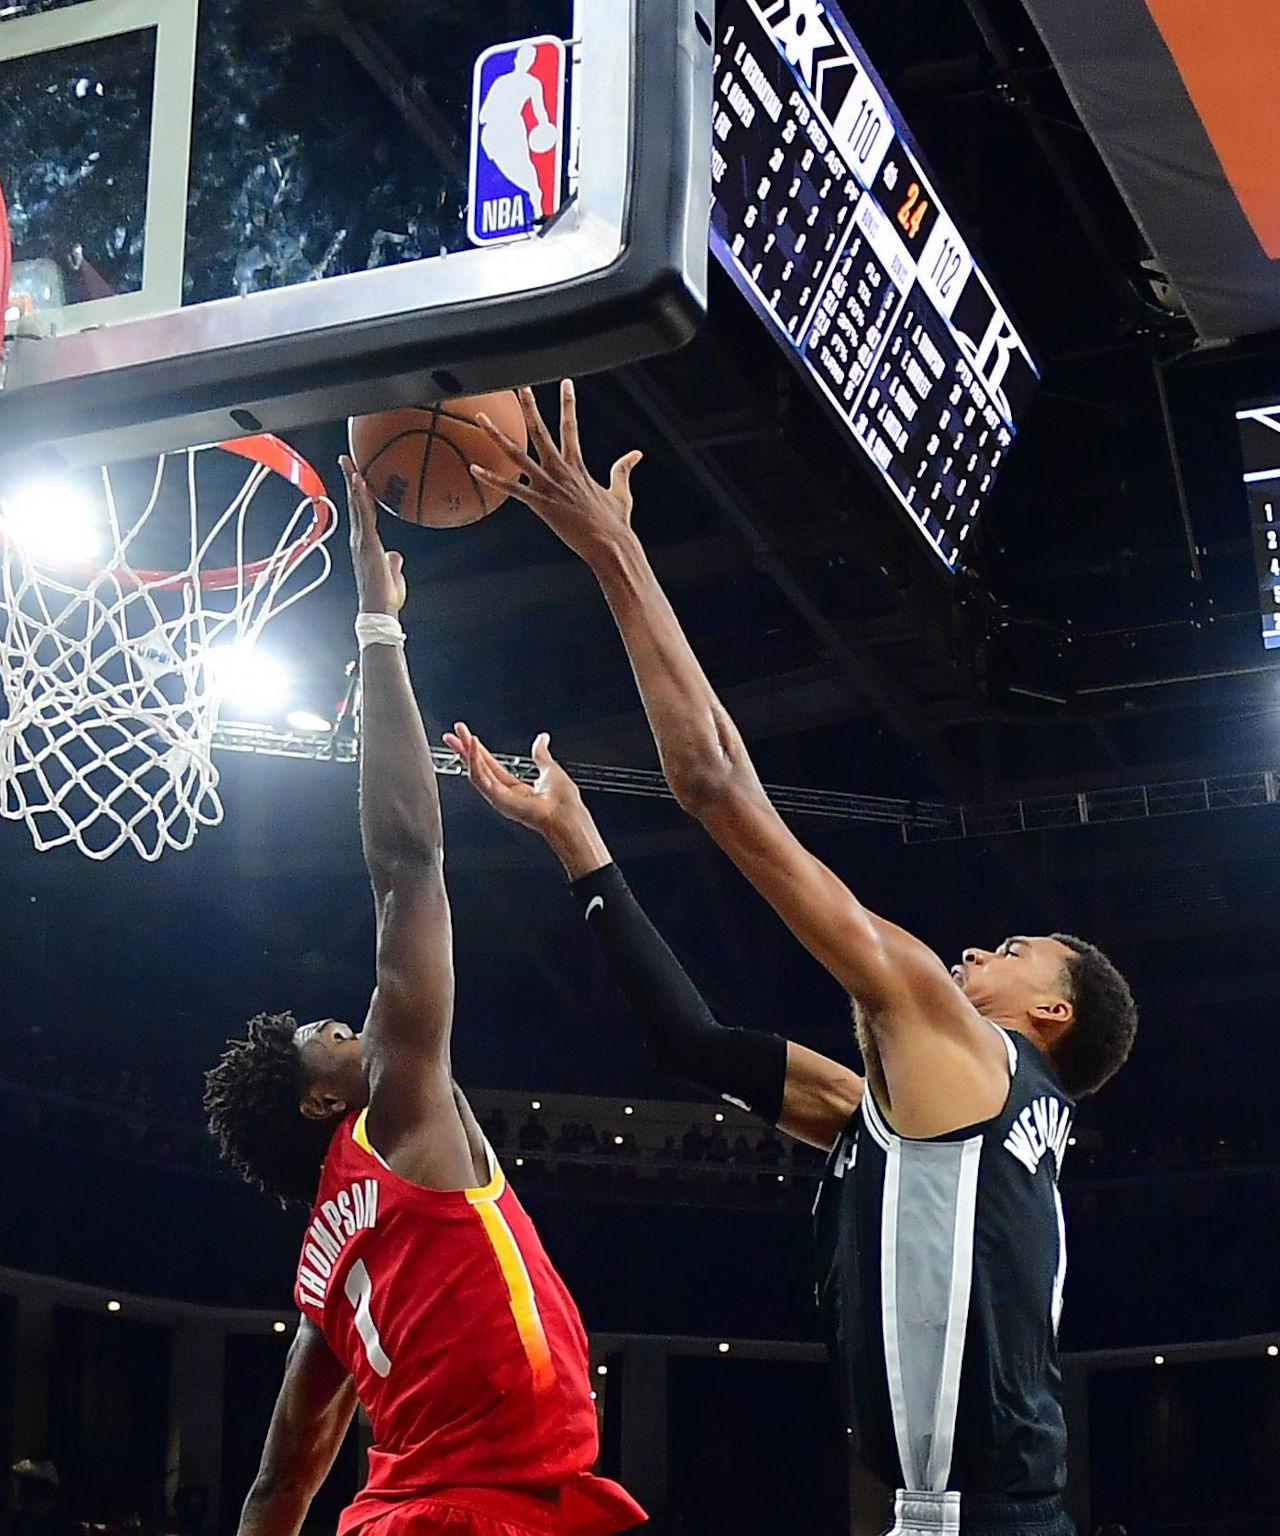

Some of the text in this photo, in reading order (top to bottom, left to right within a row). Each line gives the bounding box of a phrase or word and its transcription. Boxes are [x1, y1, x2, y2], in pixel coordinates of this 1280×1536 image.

[847, 98, 881, 164] 110
[481, 195, 525, 233] NBA
[931, 238, 961, 299] 112
[1265, 504, 1273, 522] 1
[1267, 531, 1278, 550] 2
[1271, 558, 1280, 577] 4
[297, 1179, 378, 1309] THOMPSON
[344, 1258, 392, 1378] 1
